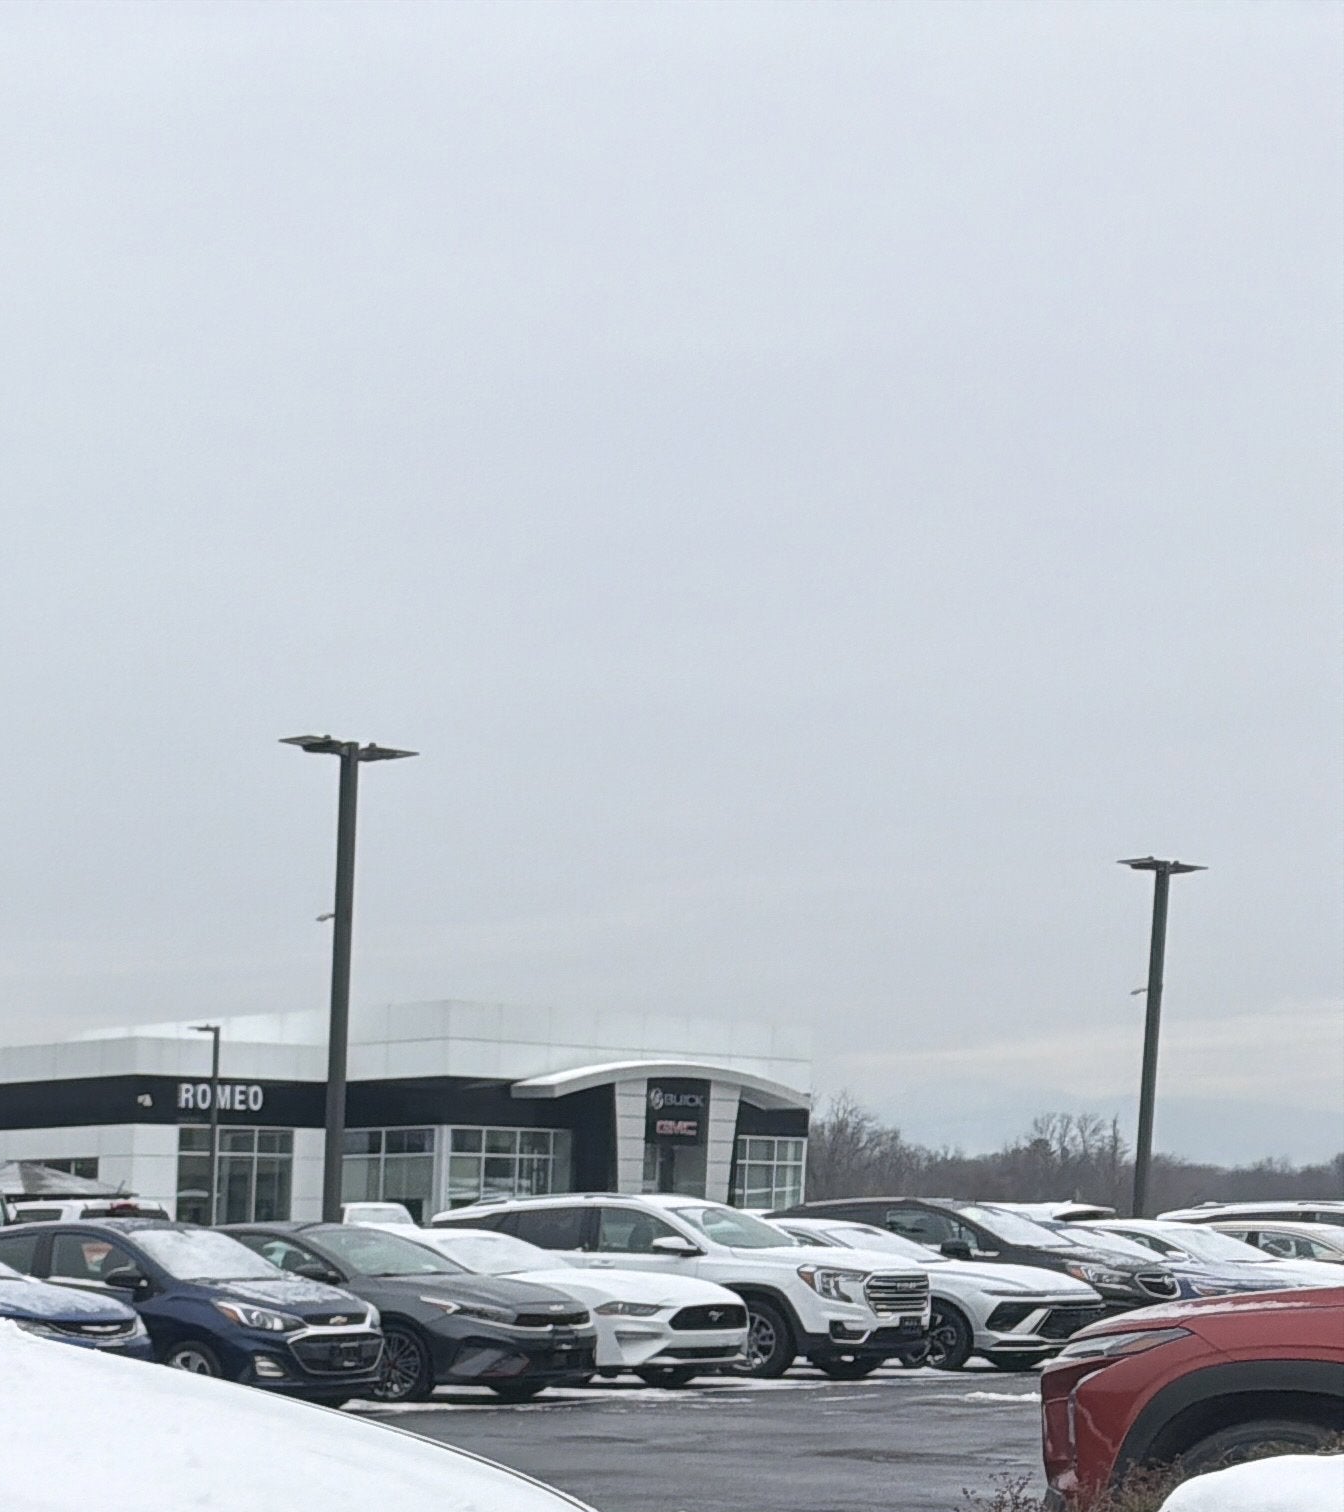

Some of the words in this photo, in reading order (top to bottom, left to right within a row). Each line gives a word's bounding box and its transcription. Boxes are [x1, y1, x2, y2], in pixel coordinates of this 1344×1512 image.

[177, 1083, 263, 1111] ROMEO
[664, 1093, 705, 1108] BUICK
[656, 1120, 698, 1136] GMC
